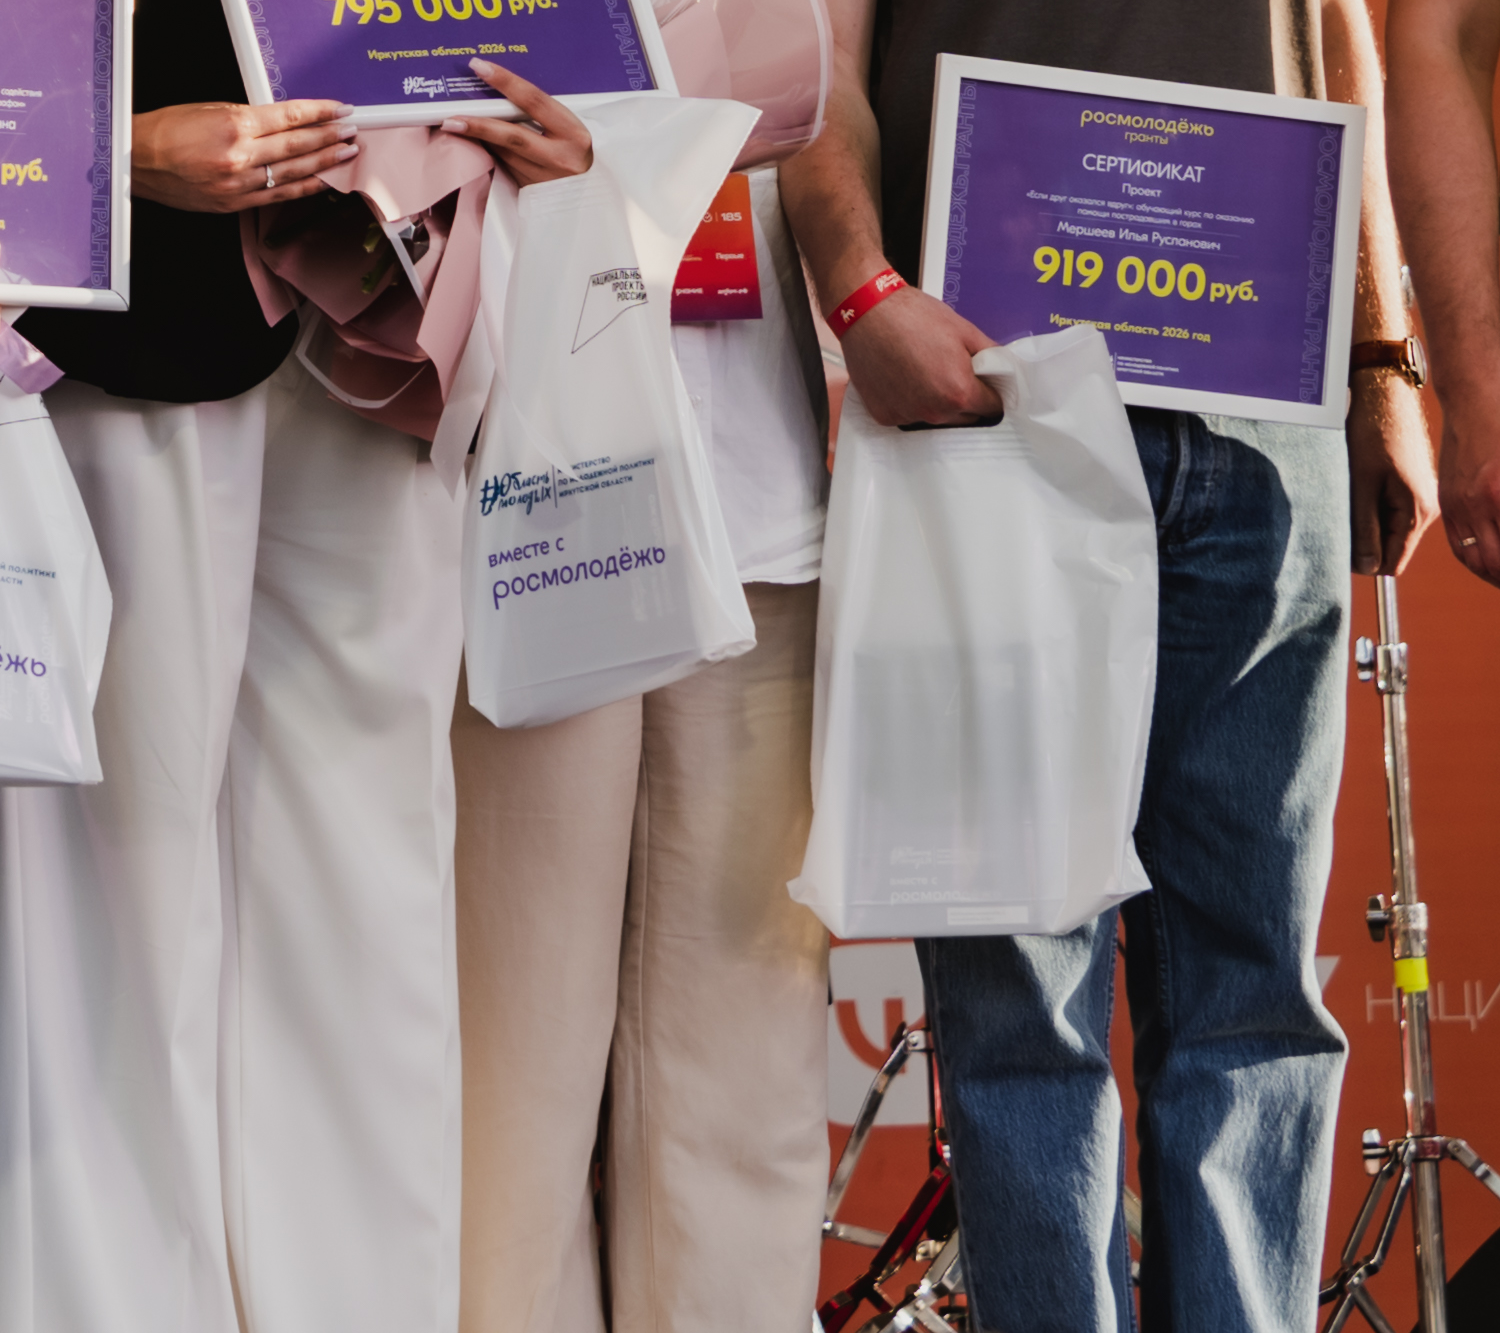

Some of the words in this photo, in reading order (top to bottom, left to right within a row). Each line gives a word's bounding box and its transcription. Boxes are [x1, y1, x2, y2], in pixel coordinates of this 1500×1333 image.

[367, 49, 430, 62] Иркутская
[430, 45, 477, 57] область
[477, 43, 507, 55] 2026
[507, 44, 529, 54] год
[1080, 109, 1215, 137] росмолодёжь
[1124, 131, 1169, 145] гранты
[1082, 153, 1206, 183] СЕРТИФИКАТ
[1121, 182, 1163, 198] Проект
[720, 211, 742, 222] 185
[1118, 227, 1149, 242] Илья
[1151, 231, 1221, 251] Русланович
[1032, 245, 1104, 289] 919
[1116, 255, 1207, 301] 000
[1209, 279, 1259, 305] руб.
[1113, 321, 1160, 336] область
[1161, 325, 1190, 340] 2026
[1191, 332, 1212, 344] год
[488, 540, 550, 568] вместе
[555, 537, 565, 552] с
[493, 546, 666, 610] росмолодёжь
